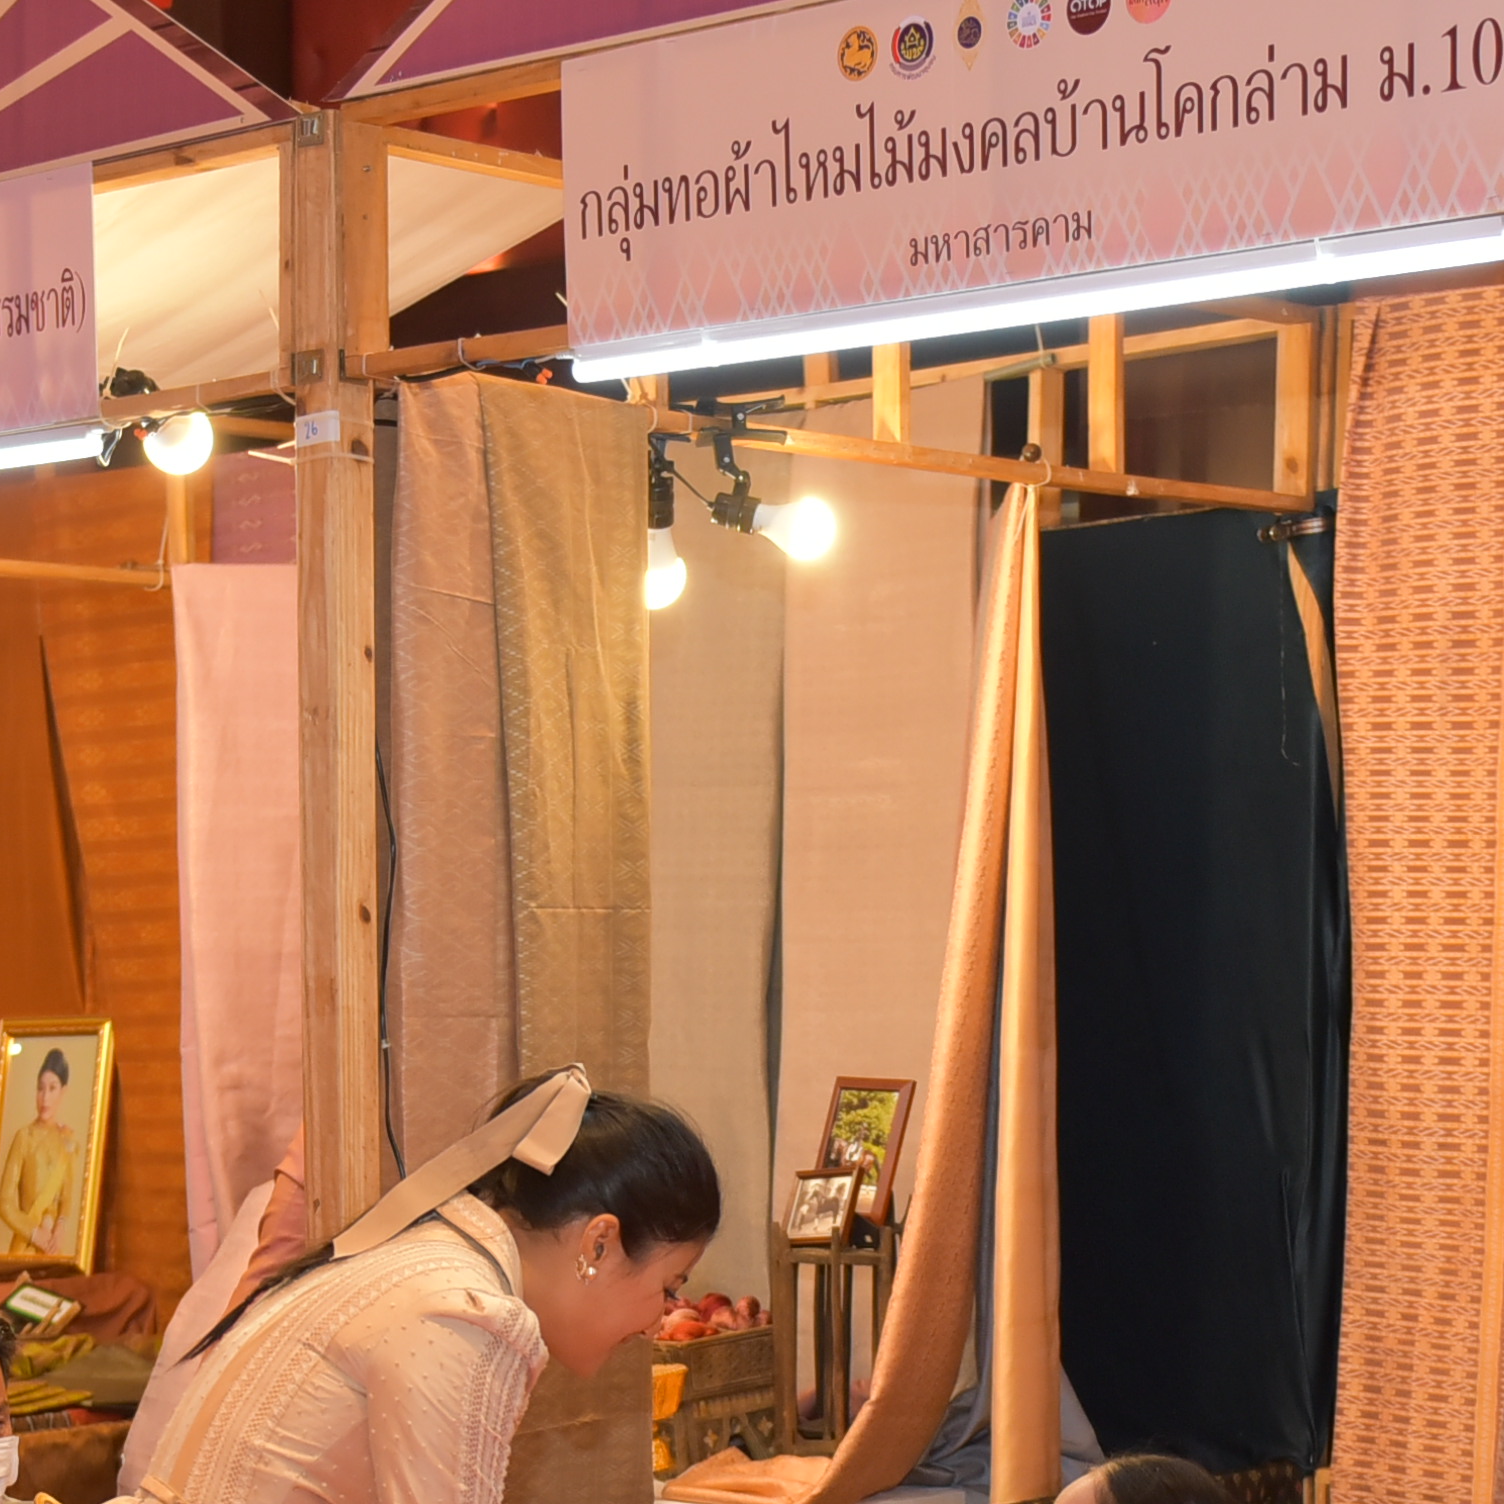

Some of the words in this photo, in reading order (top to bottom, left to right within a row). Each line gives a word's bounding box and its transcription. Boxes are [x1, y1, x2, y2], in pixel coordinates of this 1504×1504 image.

[579, 44, 1348, 262] กลุ่มทอผ้าไหมไม้มงคลบ้านโคกล่าม
[1379, 17, 1504, 102] ม.10
[909, 210, 1093, 267] มหาสารคาม
